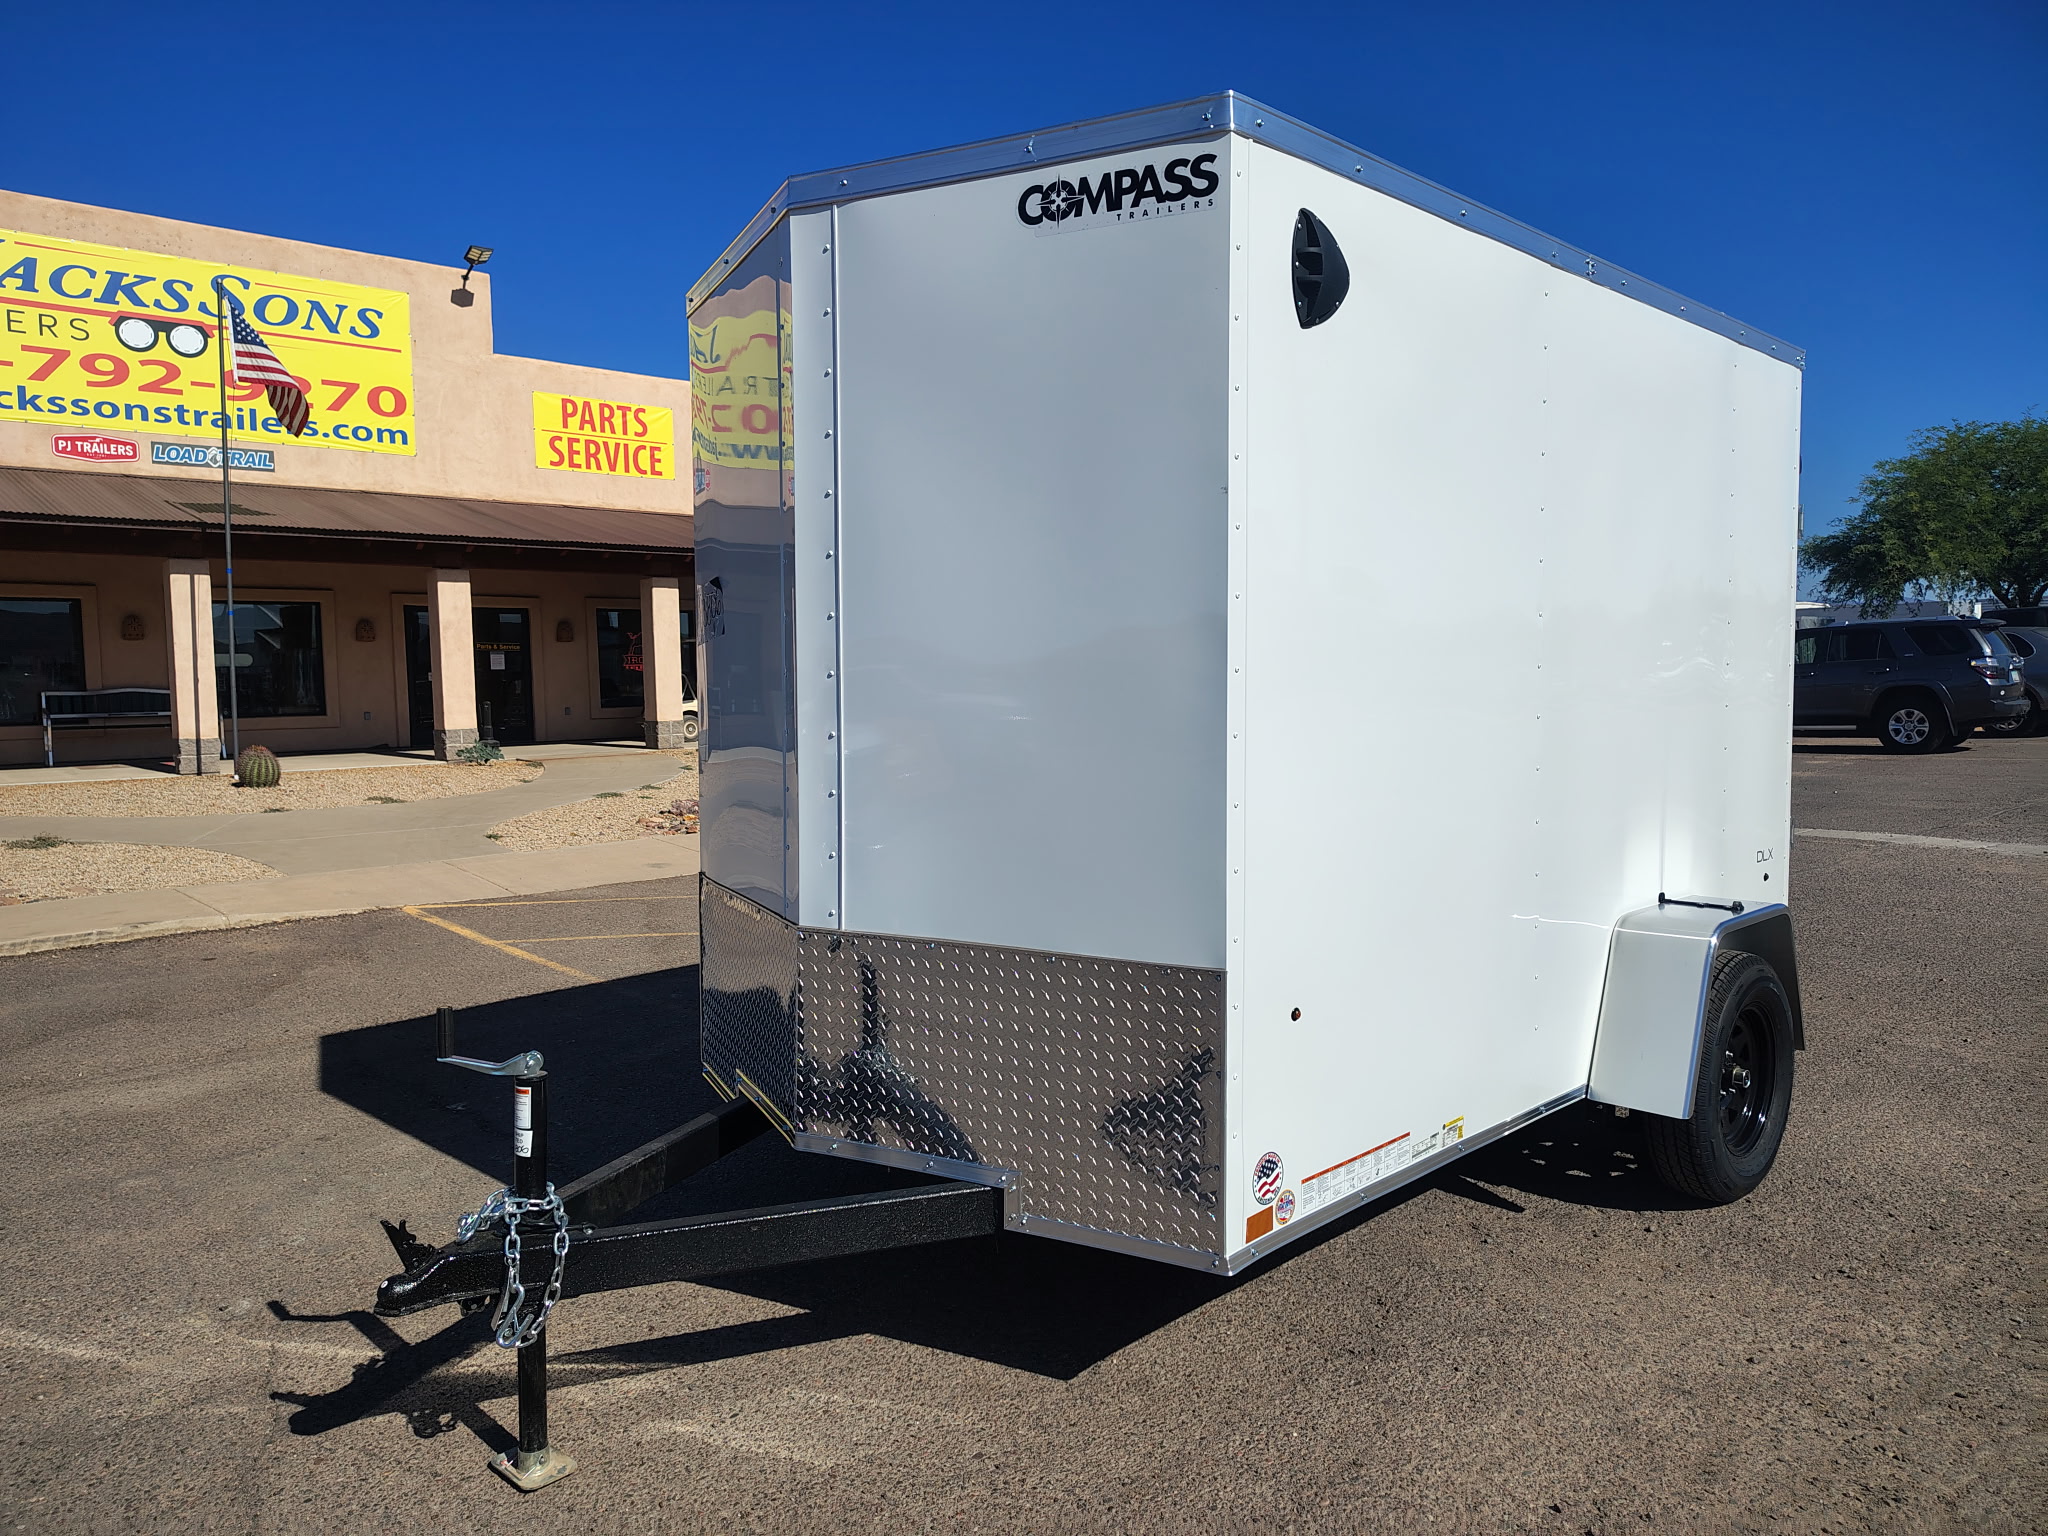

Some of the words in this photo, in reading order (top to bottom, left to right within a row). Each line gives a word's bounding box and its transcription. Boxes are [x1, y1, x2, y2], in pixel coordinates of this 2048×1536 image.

[1018, 153, 1219, 227] COMPASS
[1116, 198, 1214, 222] TRAILERS
[0, 242, 384, 339] ACKSSONS
[561, 398, 648, 437] PARTS
[58, 440, 72, 451] PJ
[75, 441, 134, 456] TRAILERS
[153, 445, 208, 464] LOAD
[218, 450, 274, 469] TRAIL
[549, 435, 663, 476] SERVICE
[1756, 847, 1774, 863] DLX
